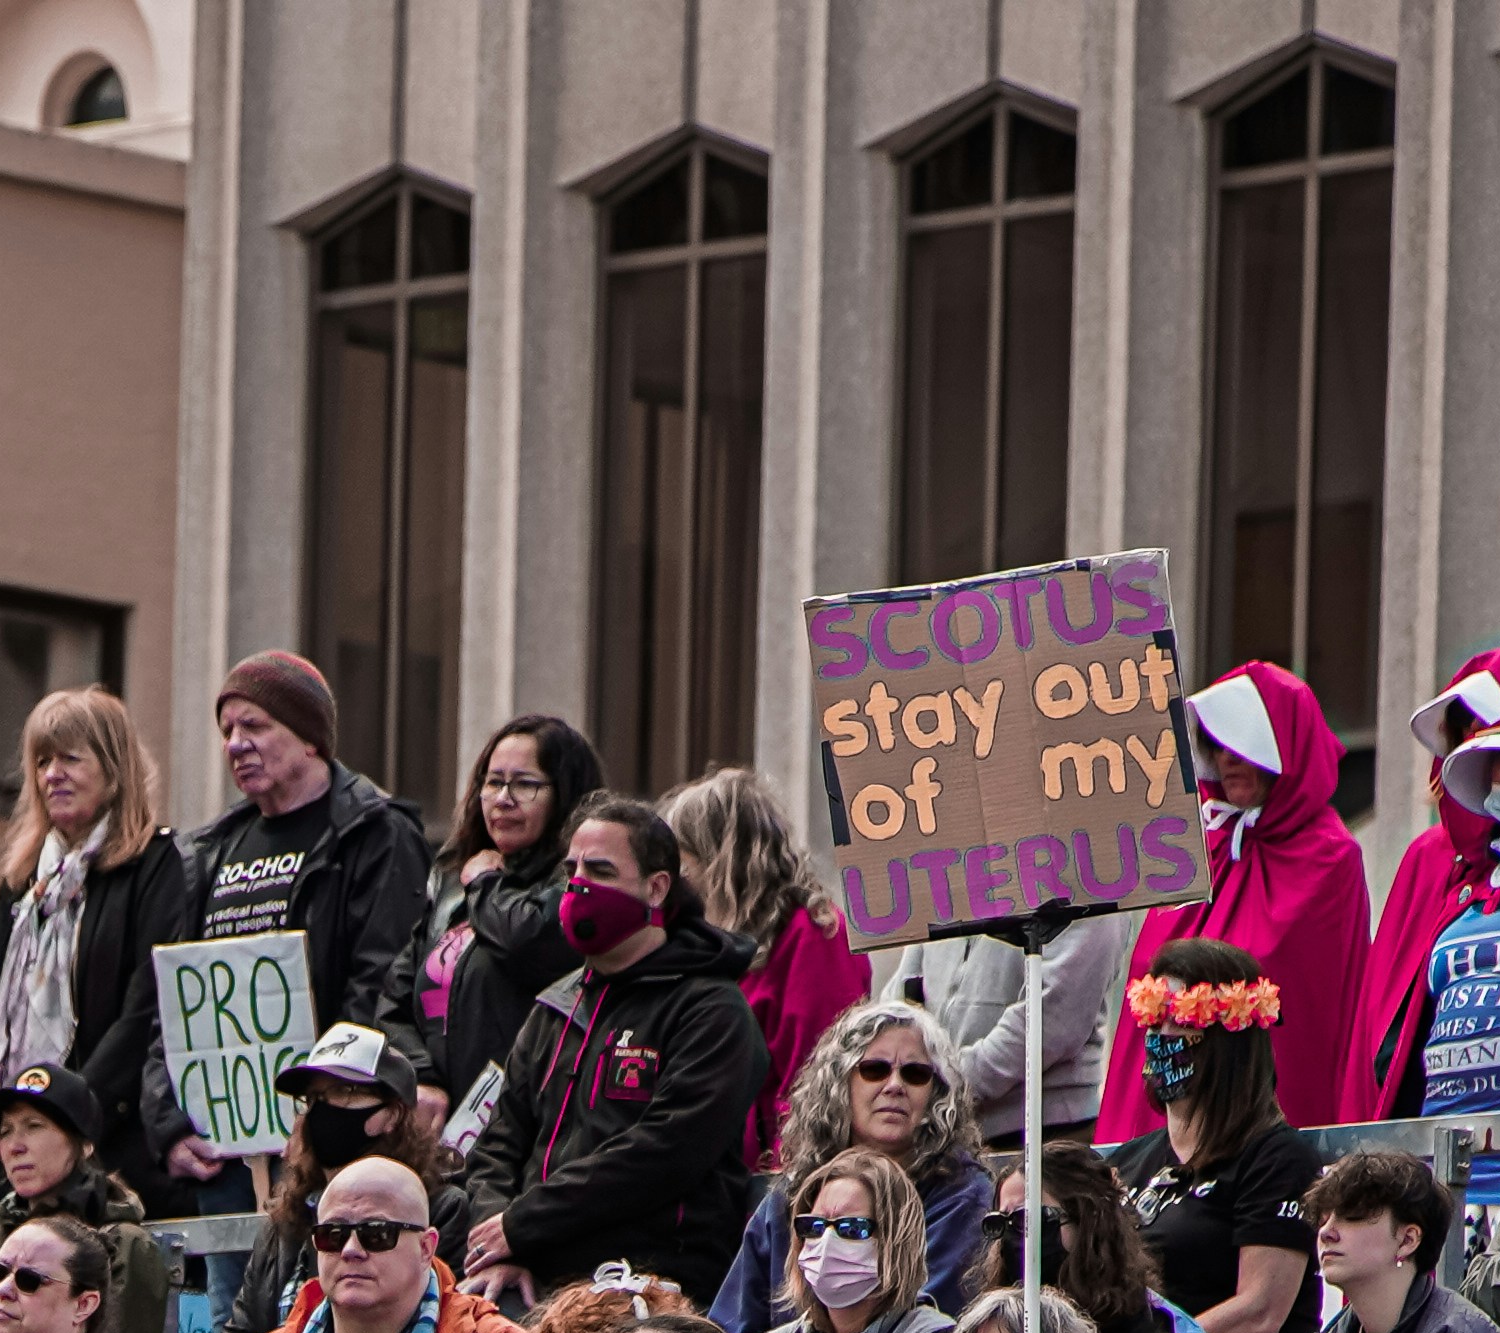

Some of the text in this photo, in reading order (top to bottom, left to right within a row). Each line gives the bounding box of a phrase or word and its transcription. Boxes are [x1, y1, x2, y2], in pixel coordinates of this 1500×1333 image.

[810, 562, 1170, 680] SCOTUS
[823, 643, 1175, 759] stay out
[850, 728, 1176, 841] of my
[216, 852, 305, 886] RO-CHOI
[842, 816, 1198, 936] UTERUS
[175, 956, 291, 1052] PRO
[180, 1045, 312, 1143] CHOIC
